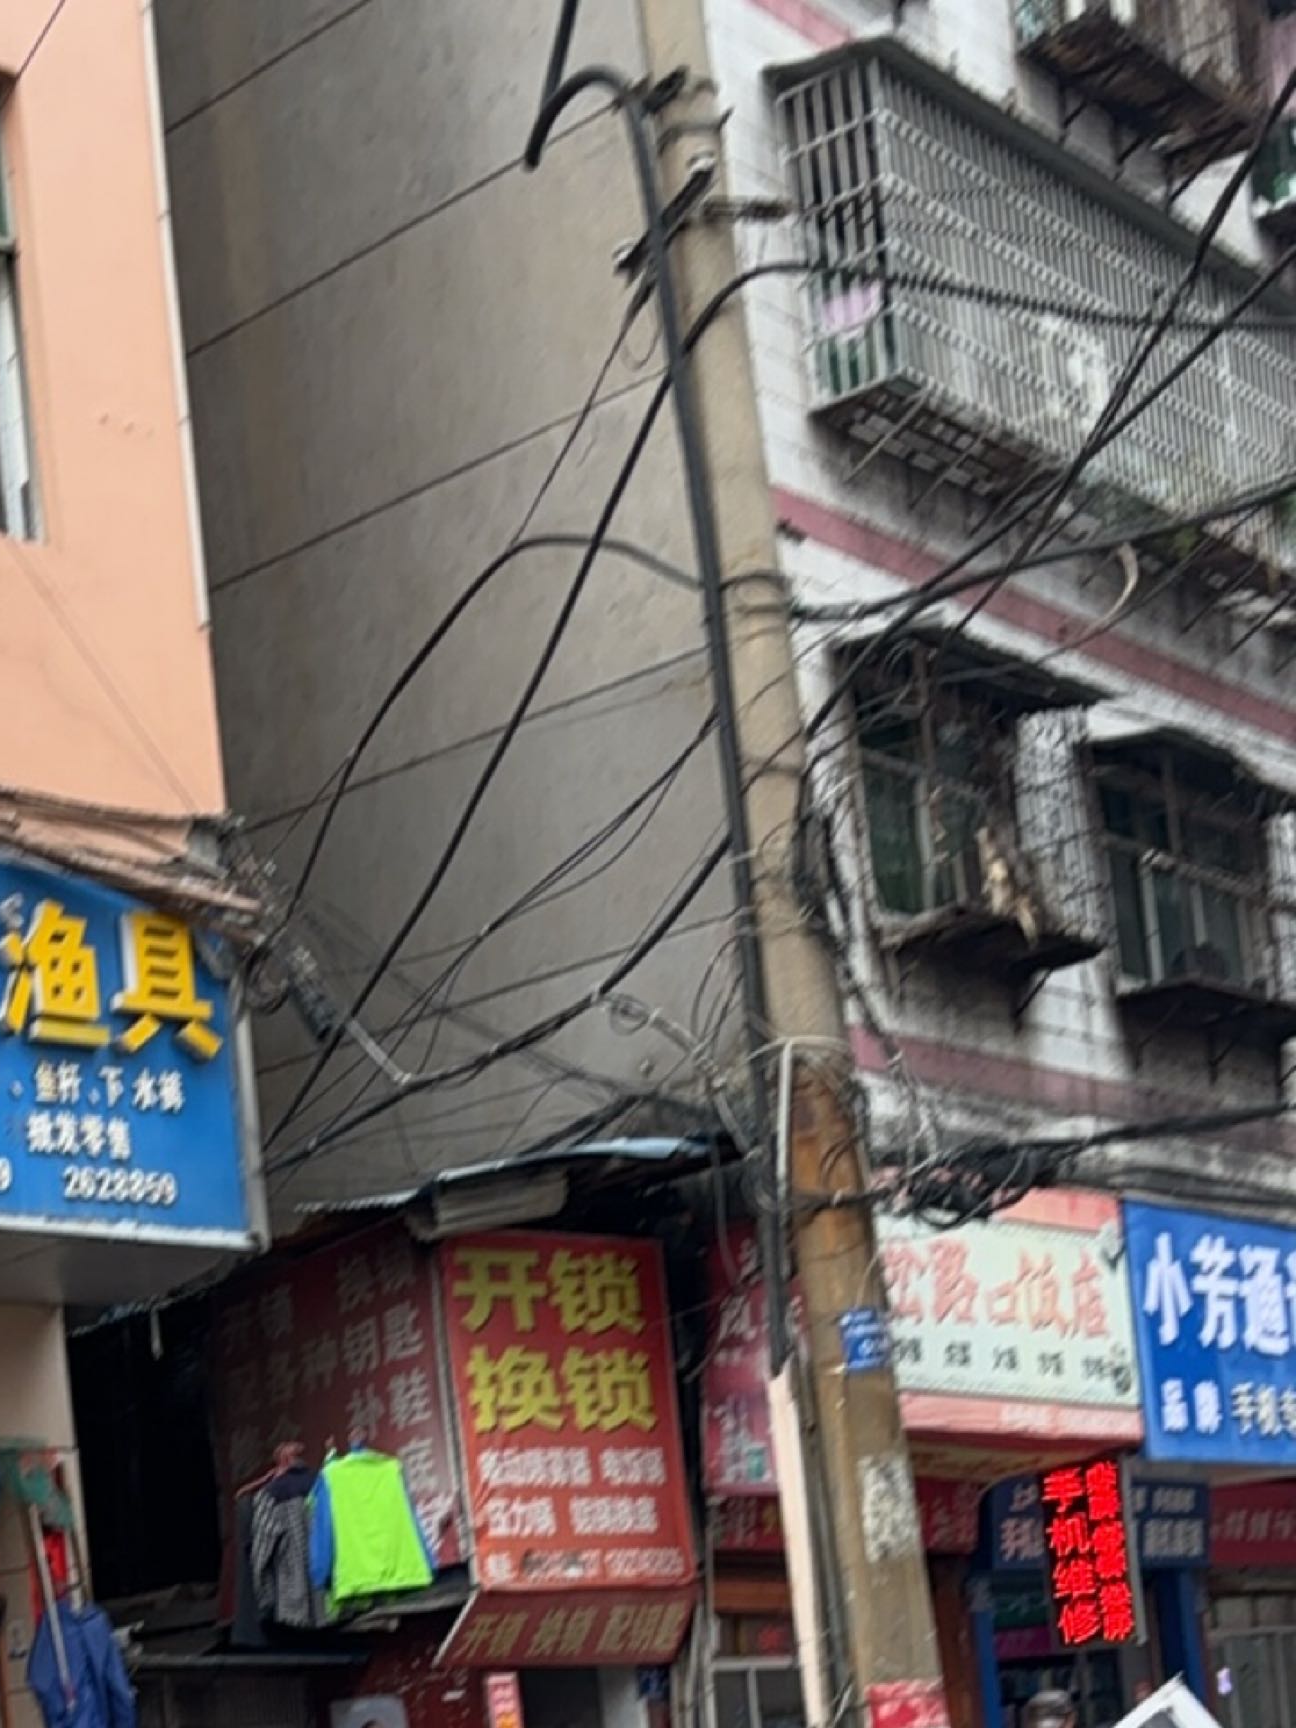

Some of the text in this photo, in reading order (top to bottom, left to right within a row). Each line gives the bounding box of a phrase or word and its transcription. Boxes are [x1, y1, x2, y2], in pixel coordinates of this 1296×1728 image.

[451, 1246, 646, 1336] 开锁
[1143, 1231, 1296, 1356] 小芳通
[466, 1343, 660, 1434] 换锁
[1042, 1466, 1101, 1645] 手机维修
